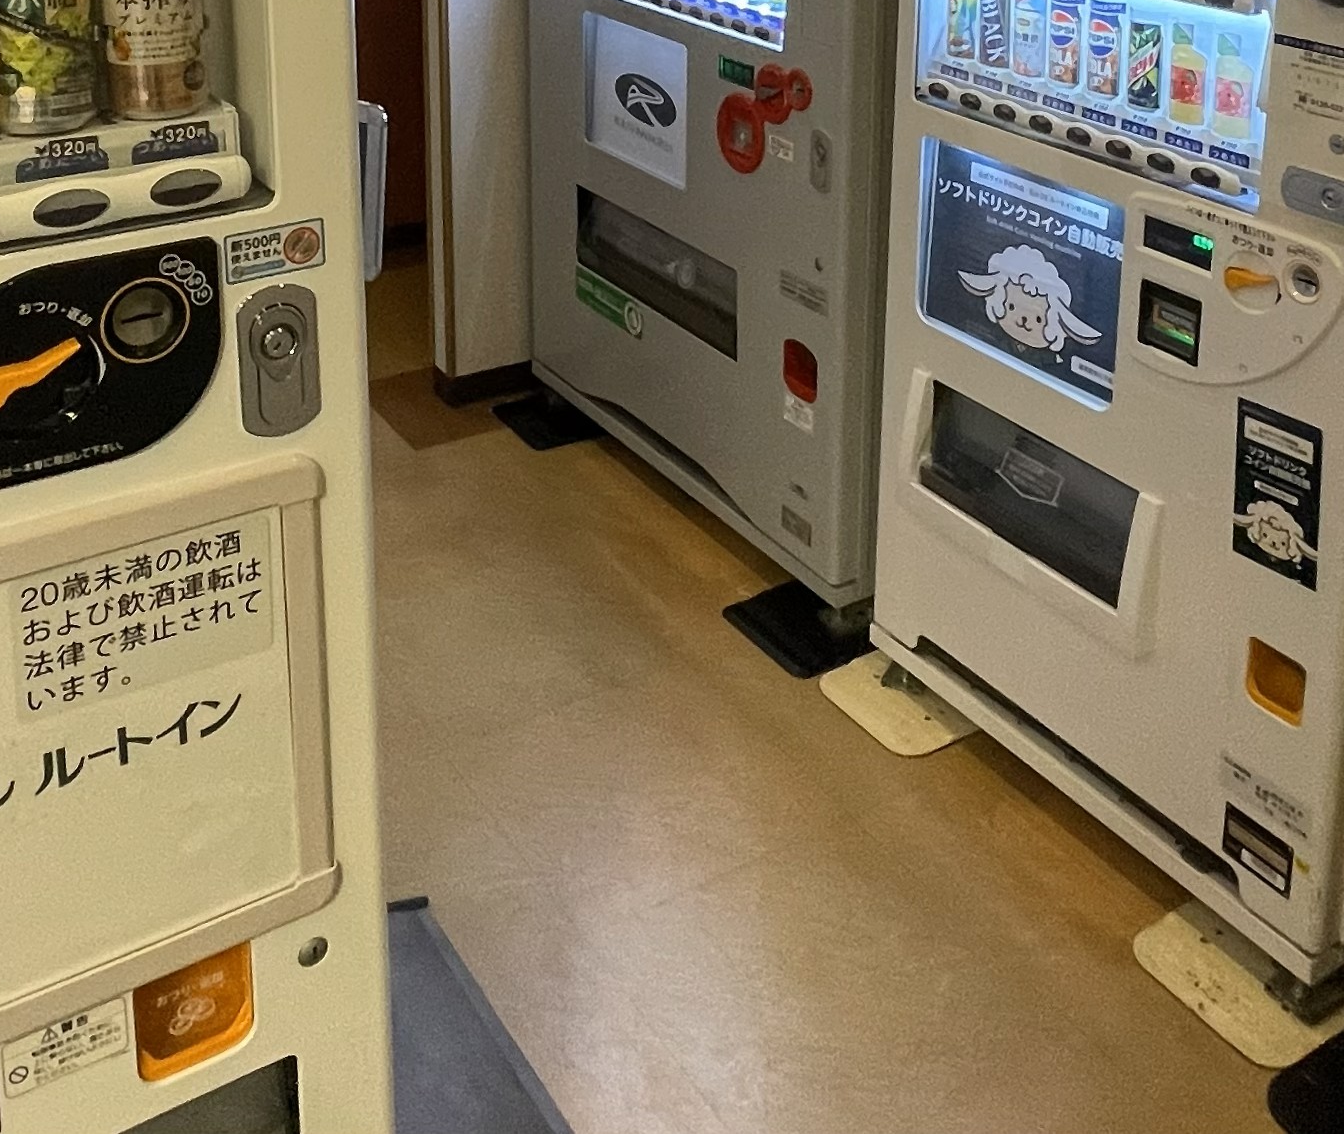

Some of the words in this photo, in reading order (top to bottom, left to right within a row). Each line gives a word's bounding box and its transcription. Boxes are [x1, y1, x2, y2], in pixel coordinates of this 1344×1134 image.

[20, 529, 242, 613] 20歳未満の飲酒
[22, 557, 262, 646] および飲酒運転は
[23, 589, 263, 681] 法律で禁止されて
[26, 665, 132, 712] います。
[34, 692, 242, 796] ルートイン
